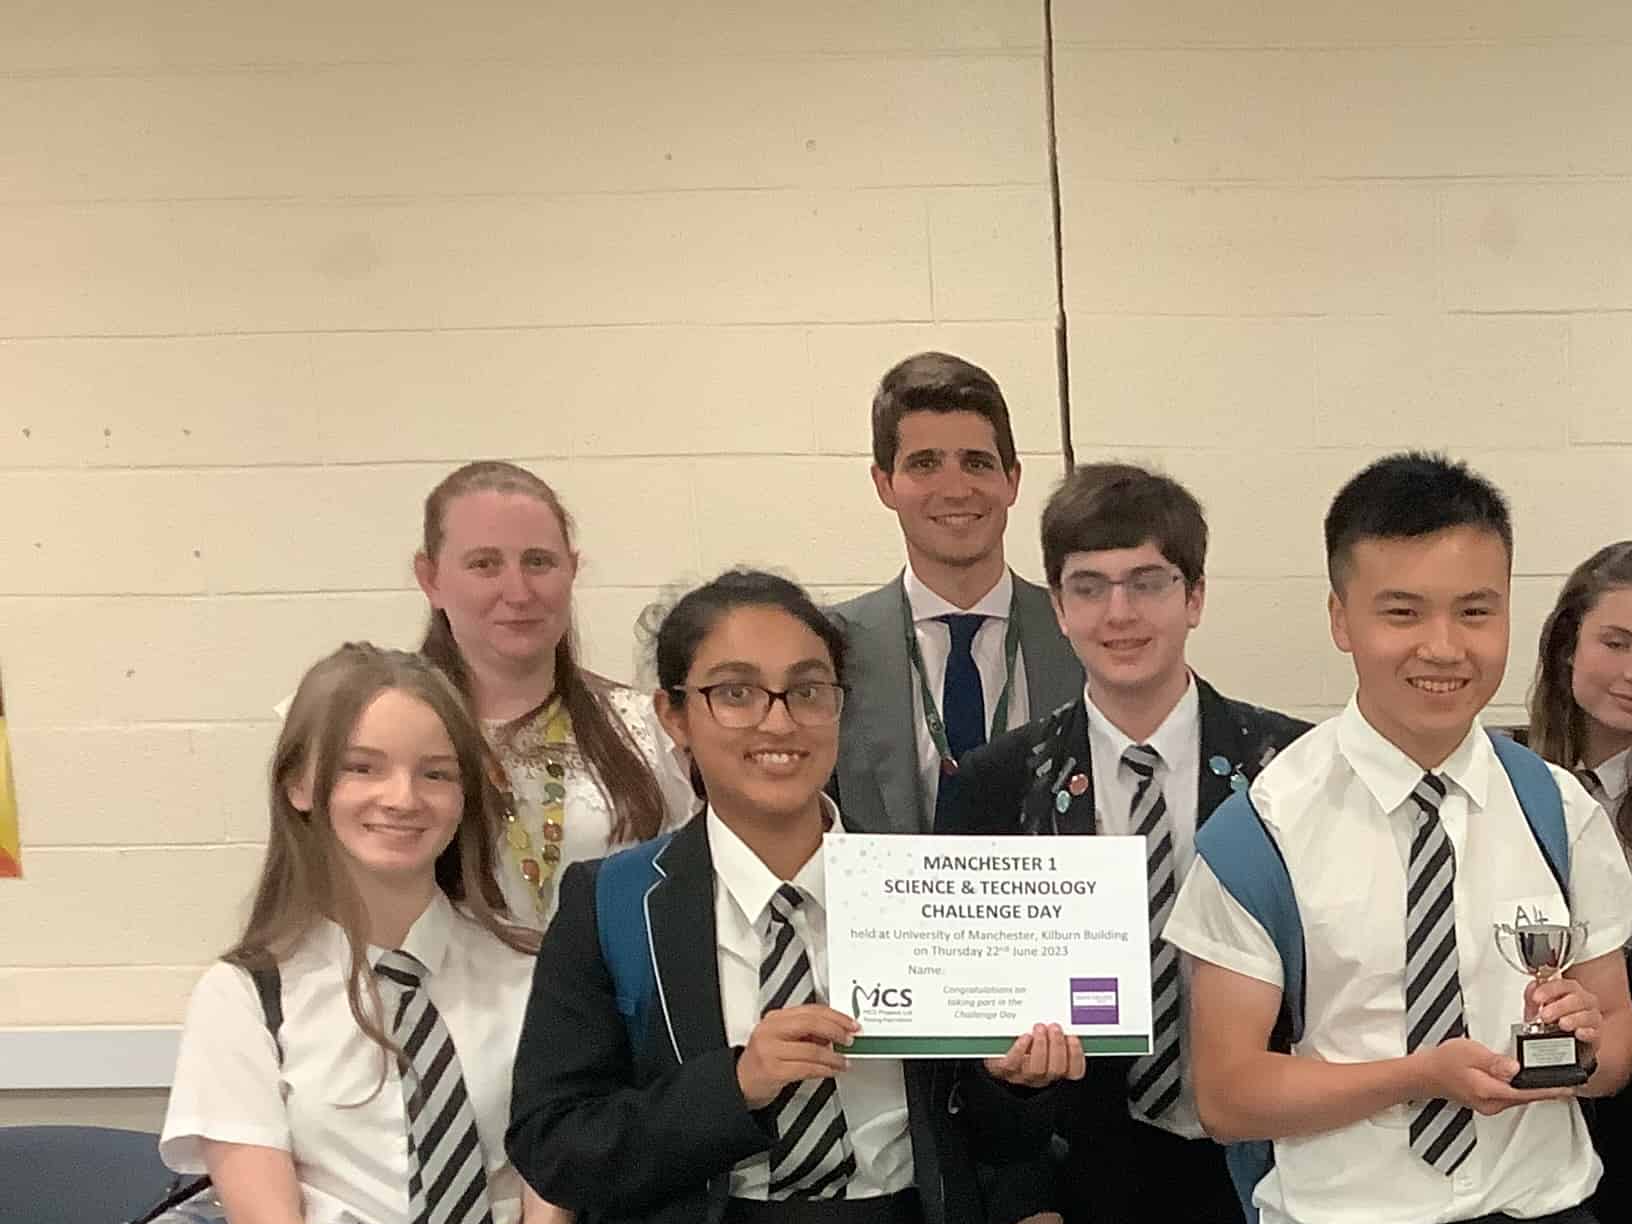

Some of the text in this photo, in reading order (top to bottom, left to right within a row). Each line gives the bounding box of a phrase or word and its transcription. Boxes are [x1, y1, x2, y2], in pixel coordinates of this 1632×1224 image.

[923, 856, 1058, 871] MANCHESTER 1
[884, 879, 1097, 895] SCIENCE & TECHNOLOGY
[920, 903, 1063, 919] CHALLENGE DAY
[850, 928, 1129, 942] held at University of Manchester, Kilburn Building
[913, 947, 929, 957] on
[931, 945, 983, 958] Thursday
[1012, 946, 1039, 957] June
[1040, 946, 1070, 957] 2023
[851, 979, 913, 1020] MCS
